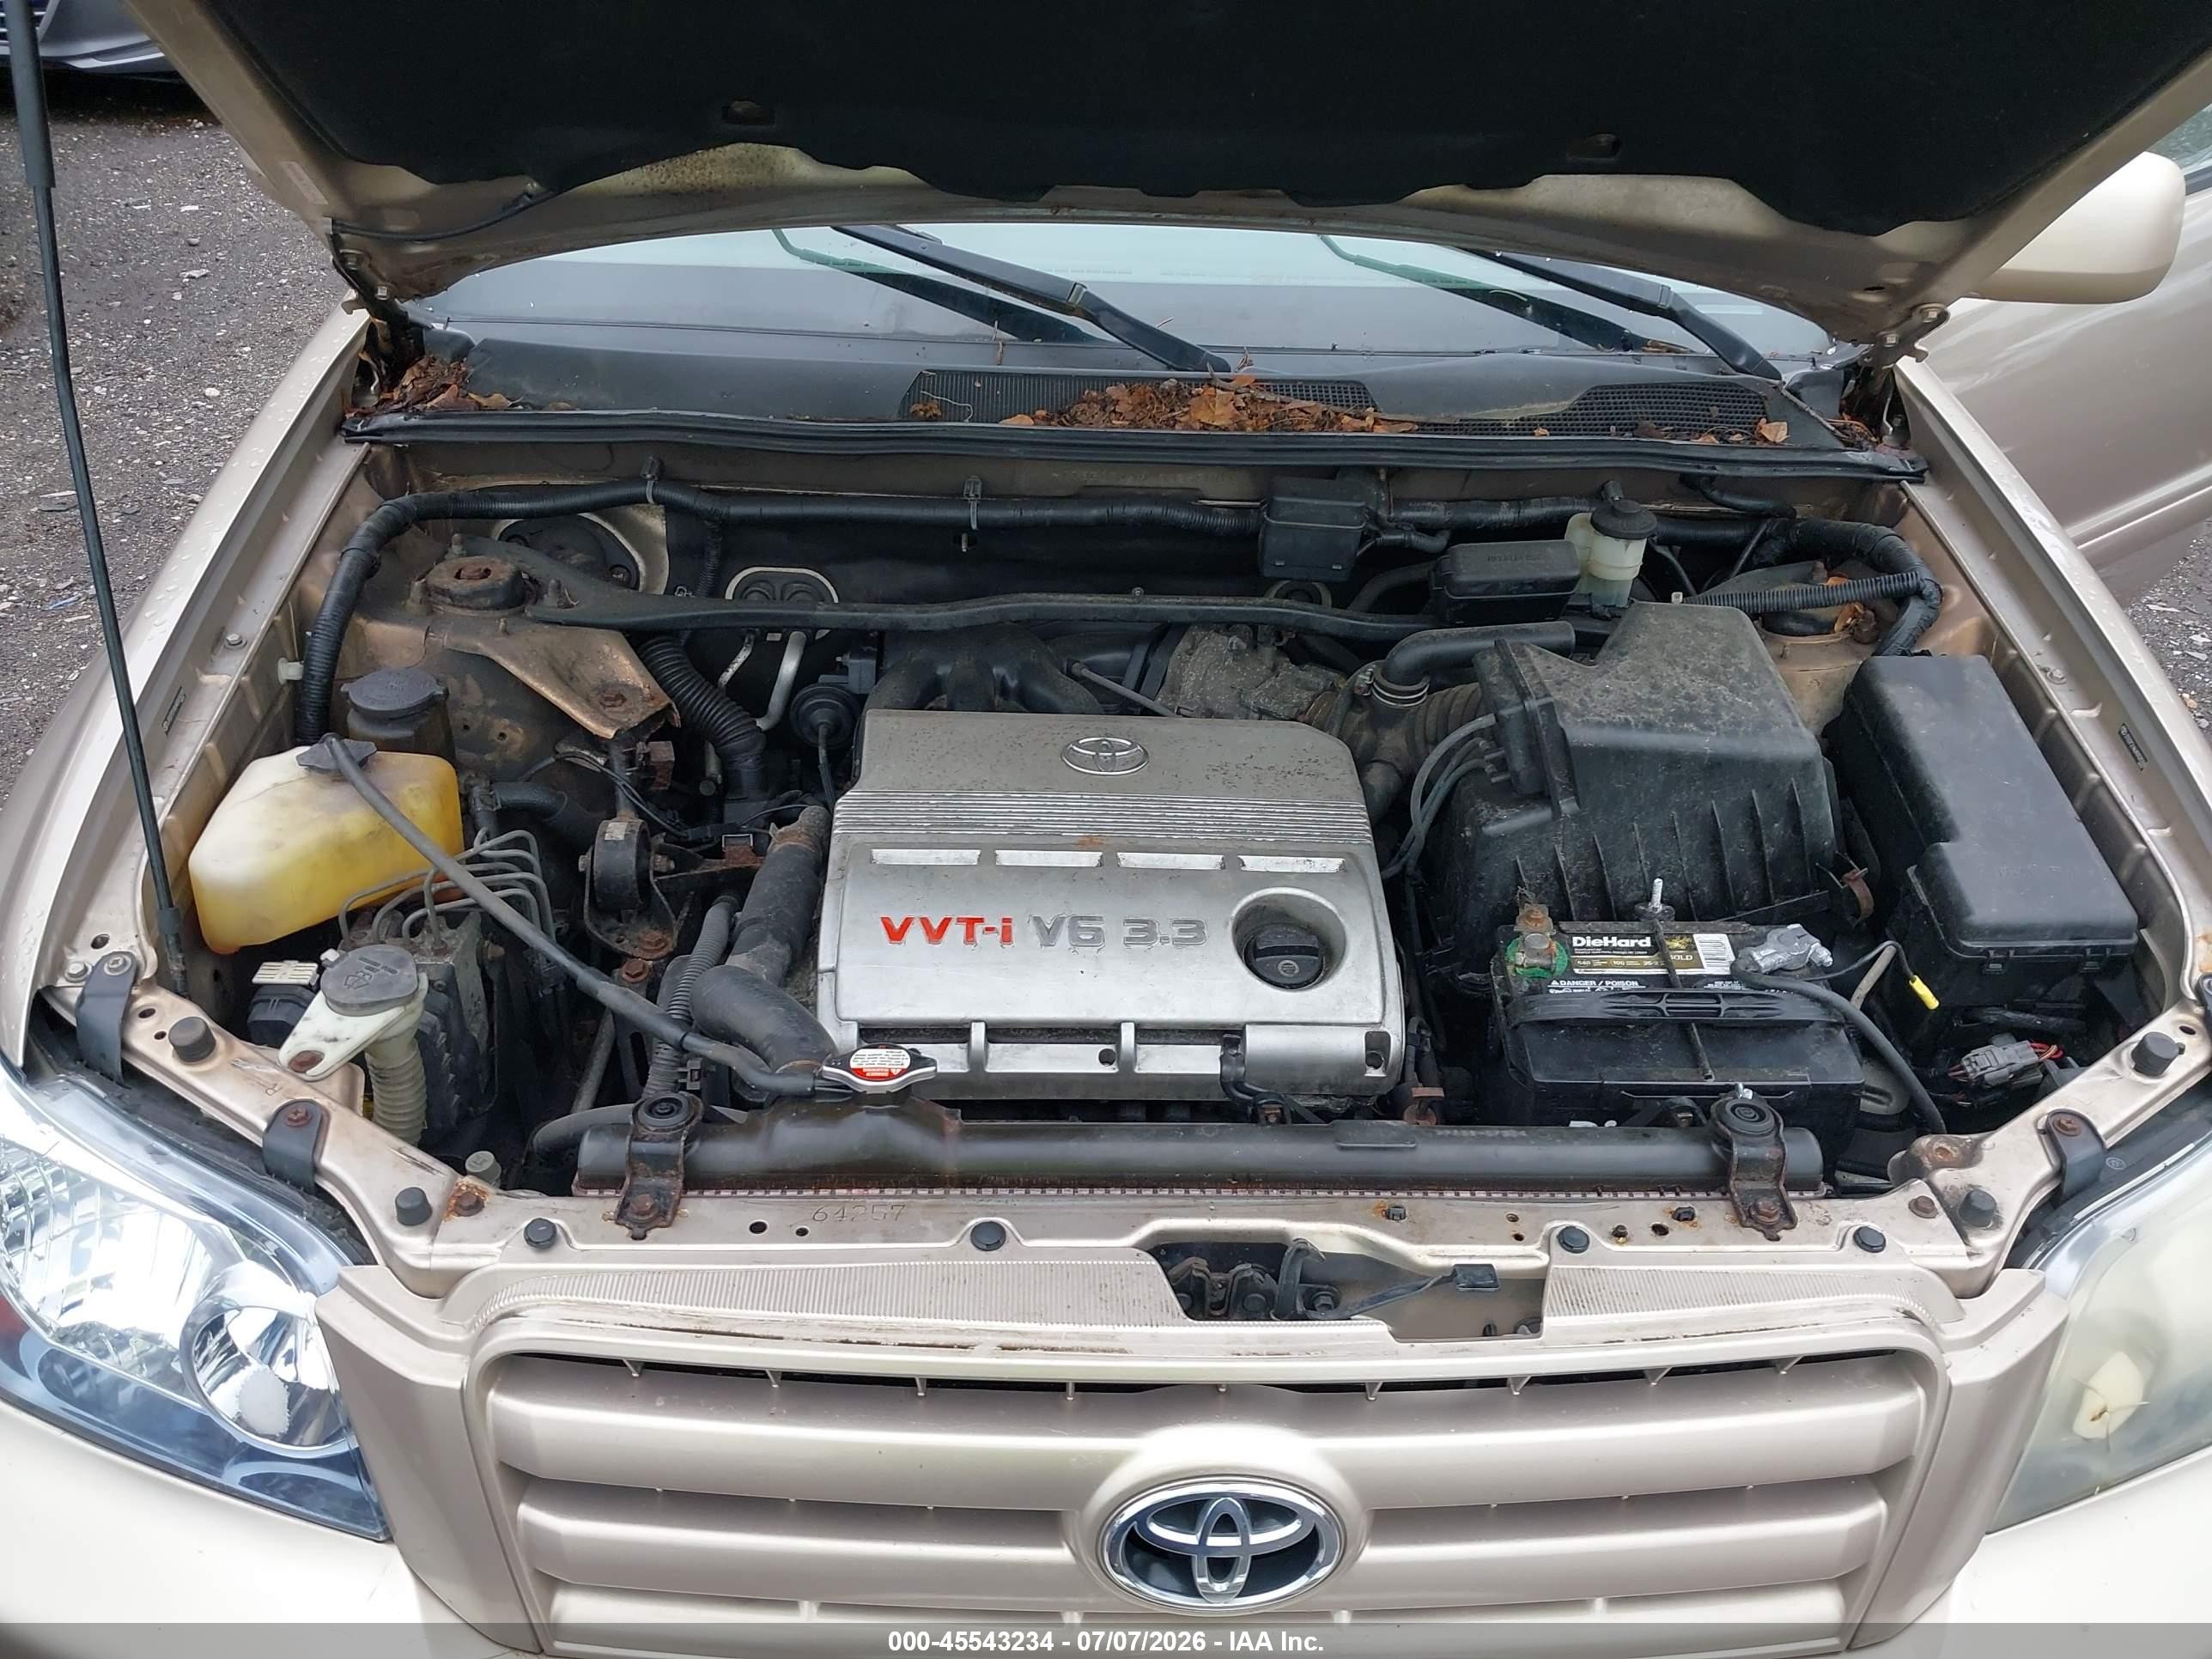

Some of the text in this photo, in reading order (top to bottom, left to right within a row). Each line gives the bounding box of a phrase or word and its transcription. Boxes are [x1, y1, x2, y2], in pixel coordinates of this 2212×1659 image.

[880, 915, 1207, 947] VVT-i V6 3.3
[1572, 936, 1651, 947] DieHard
[811, 1204, 906, 1223] 64257
